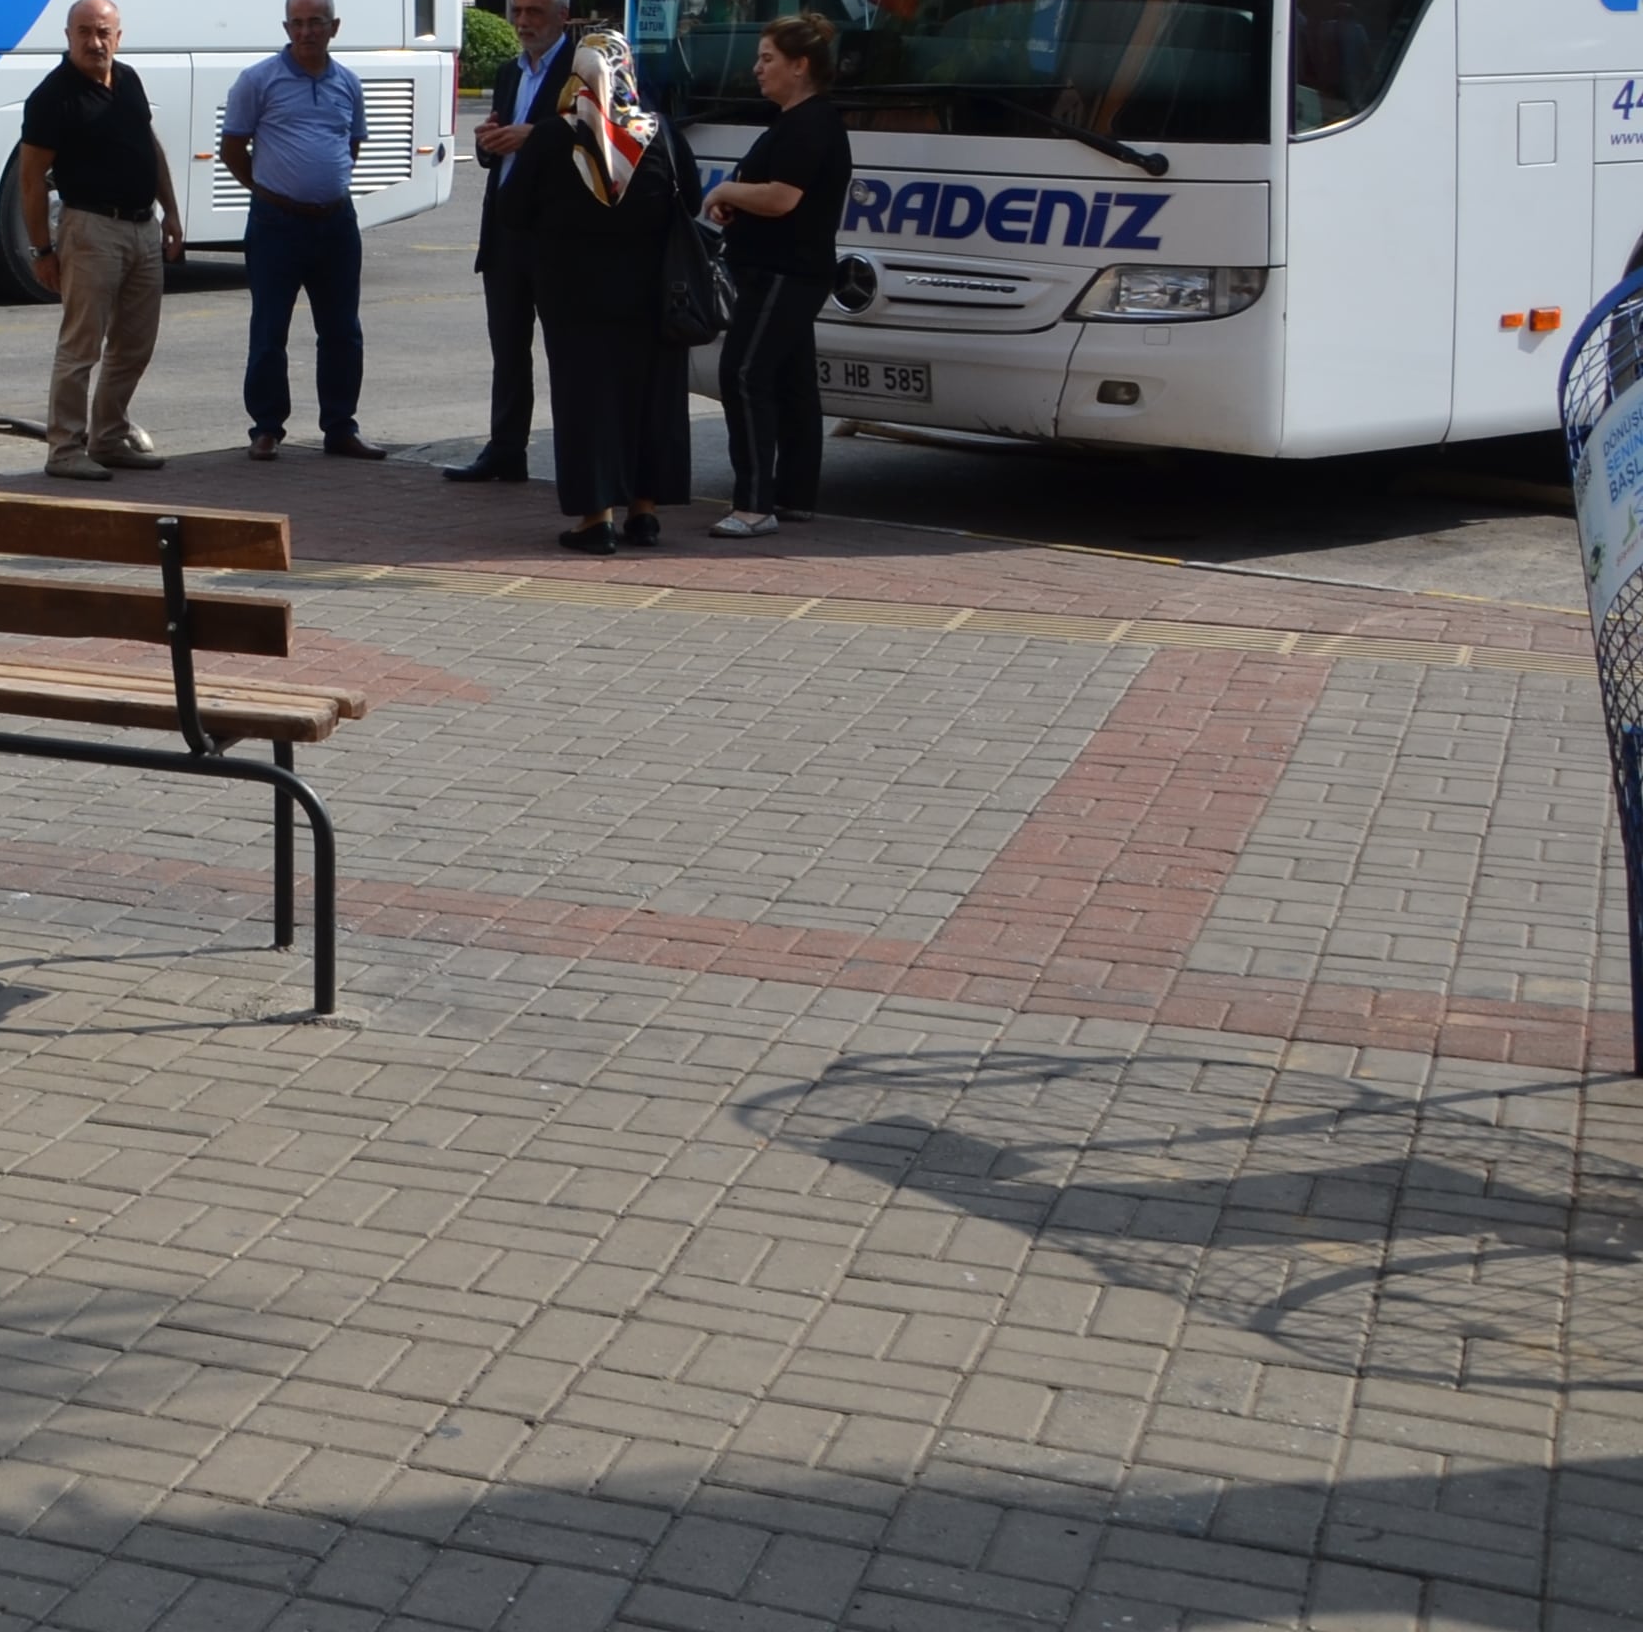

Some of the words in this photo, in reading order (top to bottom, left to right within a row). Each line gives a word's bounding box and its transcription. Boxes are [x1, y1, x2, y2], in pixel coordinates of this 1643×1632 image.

[838, 178, 1173, 251] RADENİZ
[905, 275, 1017, 293] TOURISMO
[843, 362, 870, 388] HB
[883, 366, 925, 393] 585
